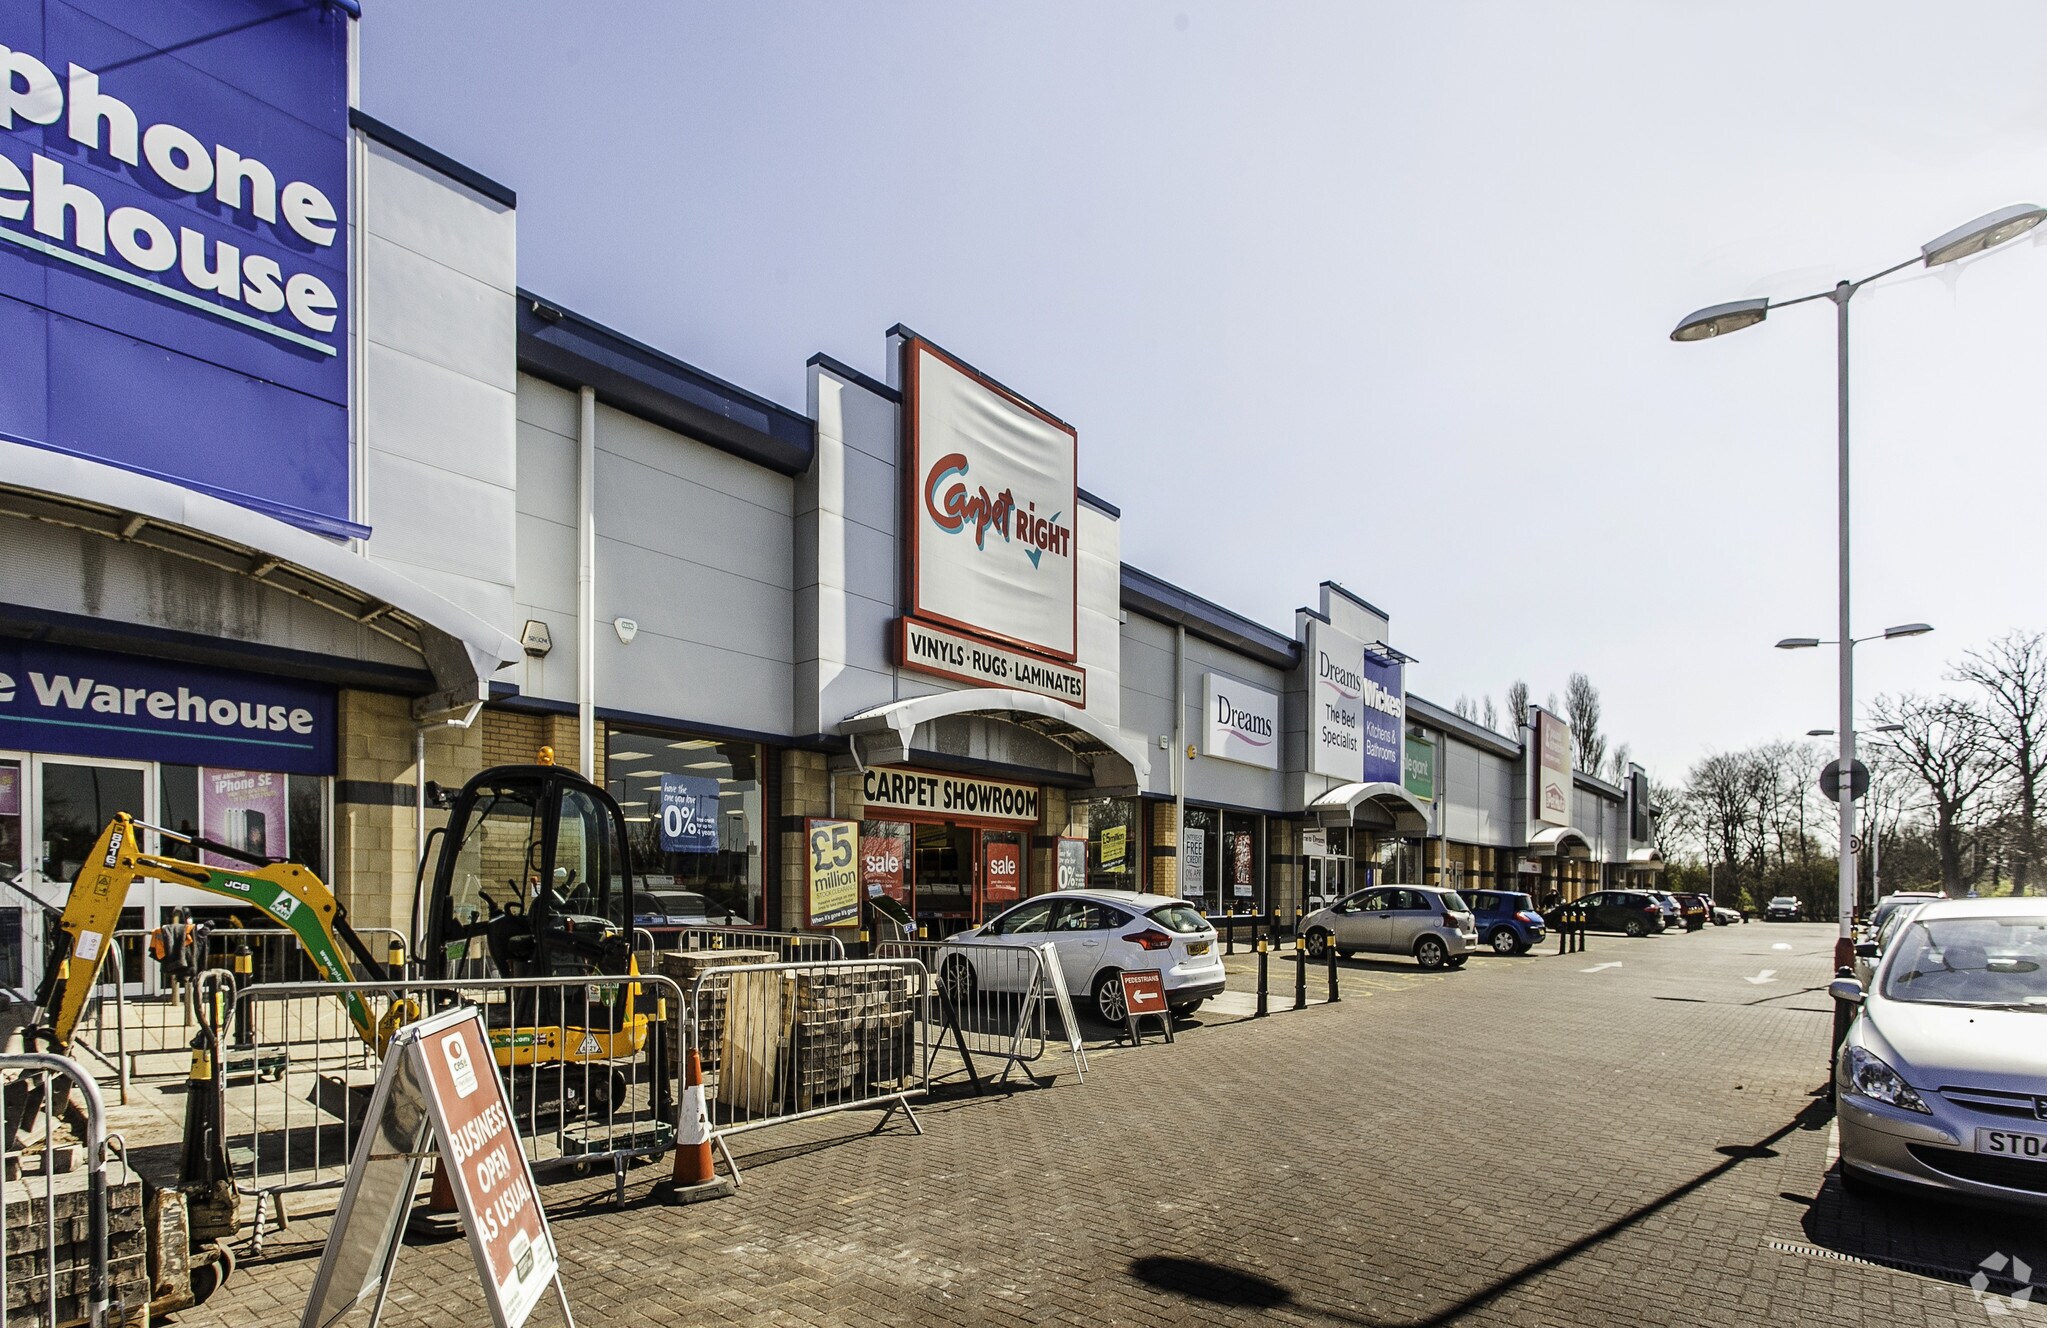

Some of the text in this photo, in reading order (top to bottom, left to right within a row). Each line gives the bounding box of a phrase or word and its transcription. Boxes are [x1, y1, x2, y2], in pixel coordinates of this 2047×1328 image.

[924, 453, 1014, 551] Carpet
[911, 632, 1082, 696] VINYLS RUGS LAMINATES
[1320, 650, 1361, 692] Dreams
[28, 671, 314, 734] Warehouse
[1363, 677, 1401, 718] Wickes
[1217, 694, 1272, 737] Dreams
[1325, 703, 1355, 729] The Bed
[1322, 726, 1357, 752] Specialist
[1366, 721, 1396, 744] Kitchens &
[1366, 739, 1397, 763] Bathrooms
[215, 778, 255, 794] iPhone
[258, 773, 273, 787] SE
[664, 782, 688, 794] have the
[863, 770, 1038, 817] CARPET SHOWROOM
[664, 794, 674, 802] one
[675, 795, 685, 805] you
[664, 805, 697, 837] 0%
[105, 832, 123, 864] 8016
[812, 826, 852, 873] £5
[1186, 841, 1203, 855] FREE
[866, 851, 899, 873] sale
[990, 856, 1016, 875] sale
[224, 880, 251, 892] JCB
[815, 870, 856, 892] million
[1058, 865, 1075, 889] 0%
[816, 885, 856, 899] STOCK CLEARANCE
[271, 904, 290, 920] PLANT
[1124, 975, 1159, 984] PEDESTRIANS
[451, 1100, 508, 1165] BUSINESS
[476, 1144, 511, 1194] OPEN
[478, 1173, 532, 1243] AS USUAL
